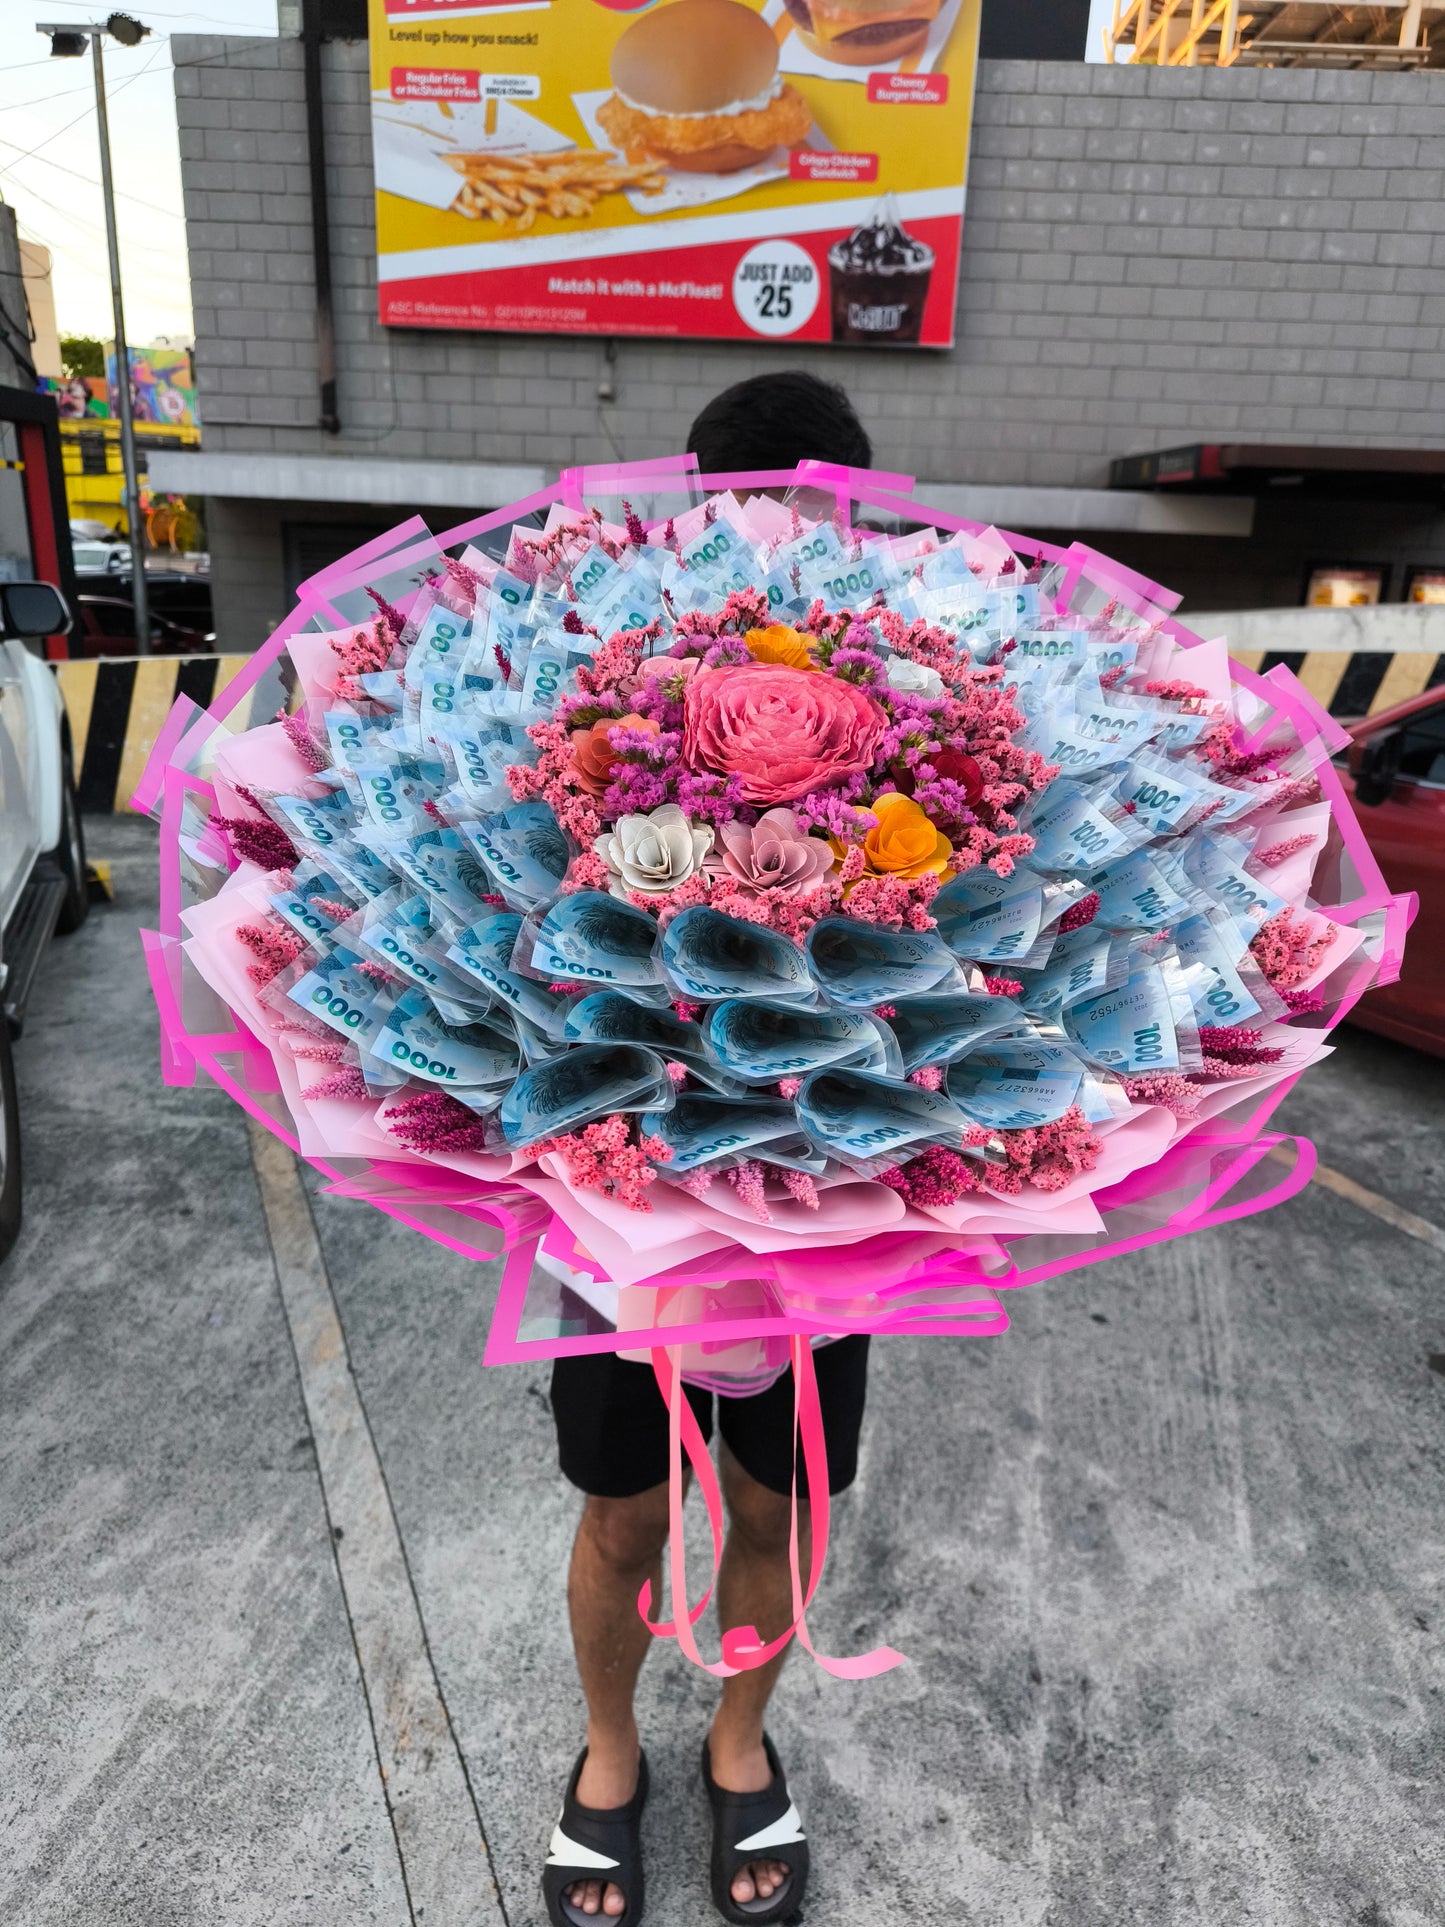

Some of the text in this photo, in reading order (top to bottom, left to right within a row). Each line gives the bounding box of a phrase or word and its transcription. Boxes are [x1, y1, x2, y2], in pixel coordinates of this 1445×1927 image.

[389, 28, 538, 48] Level up how you snack!
[395, 85, 477, 98] or McShaker Fries
[406, 71, 467, 88] Regular Fries
[890, 76, 927, 90] Cheesy
[876, 89, 940, 103] Burger McDo
[799, 154, 871, 169] Crispy Chicken
[810, 167, 858, 179] Sandwich
[739, 264, 813, 283] JUST ADD
[548, 277, 723, 299] Match it with a McFloat!
[823, 569, 873, 600] 1000
[460, 740, 493, 787] 1000
[1049, 740, 1101, 766] 1000
[1130, 780, 1181, 815] 1000
[1069, 820, 1110, 854] 1000
[476, 833, 524, 884] 1000
[399, 851, 449, 895] 1000
[987, 930, 1025, 956] 1000
[381, 937, 439, 985] 1000
[549, 955, 618, 980] 1000
[464, 955, 521, 1004] 1000
[684, 978, 753, 995] 1000
[1068, 957, 1095, 993] 1000
[311, 985, 377, 1036] 1000
[1089, 993, 1145, 1021] CE7967552
[1133, 1022, 1163, 1063] 1000
[392, 1040, 460, 1081] 1000
[750, 1057, 818, 1073] 1000
[996, 1083, 1056, 1095] AA8663277
[678, 1134, 751, 1162] 1000
[846, 1126, 911, 1149] 1000
